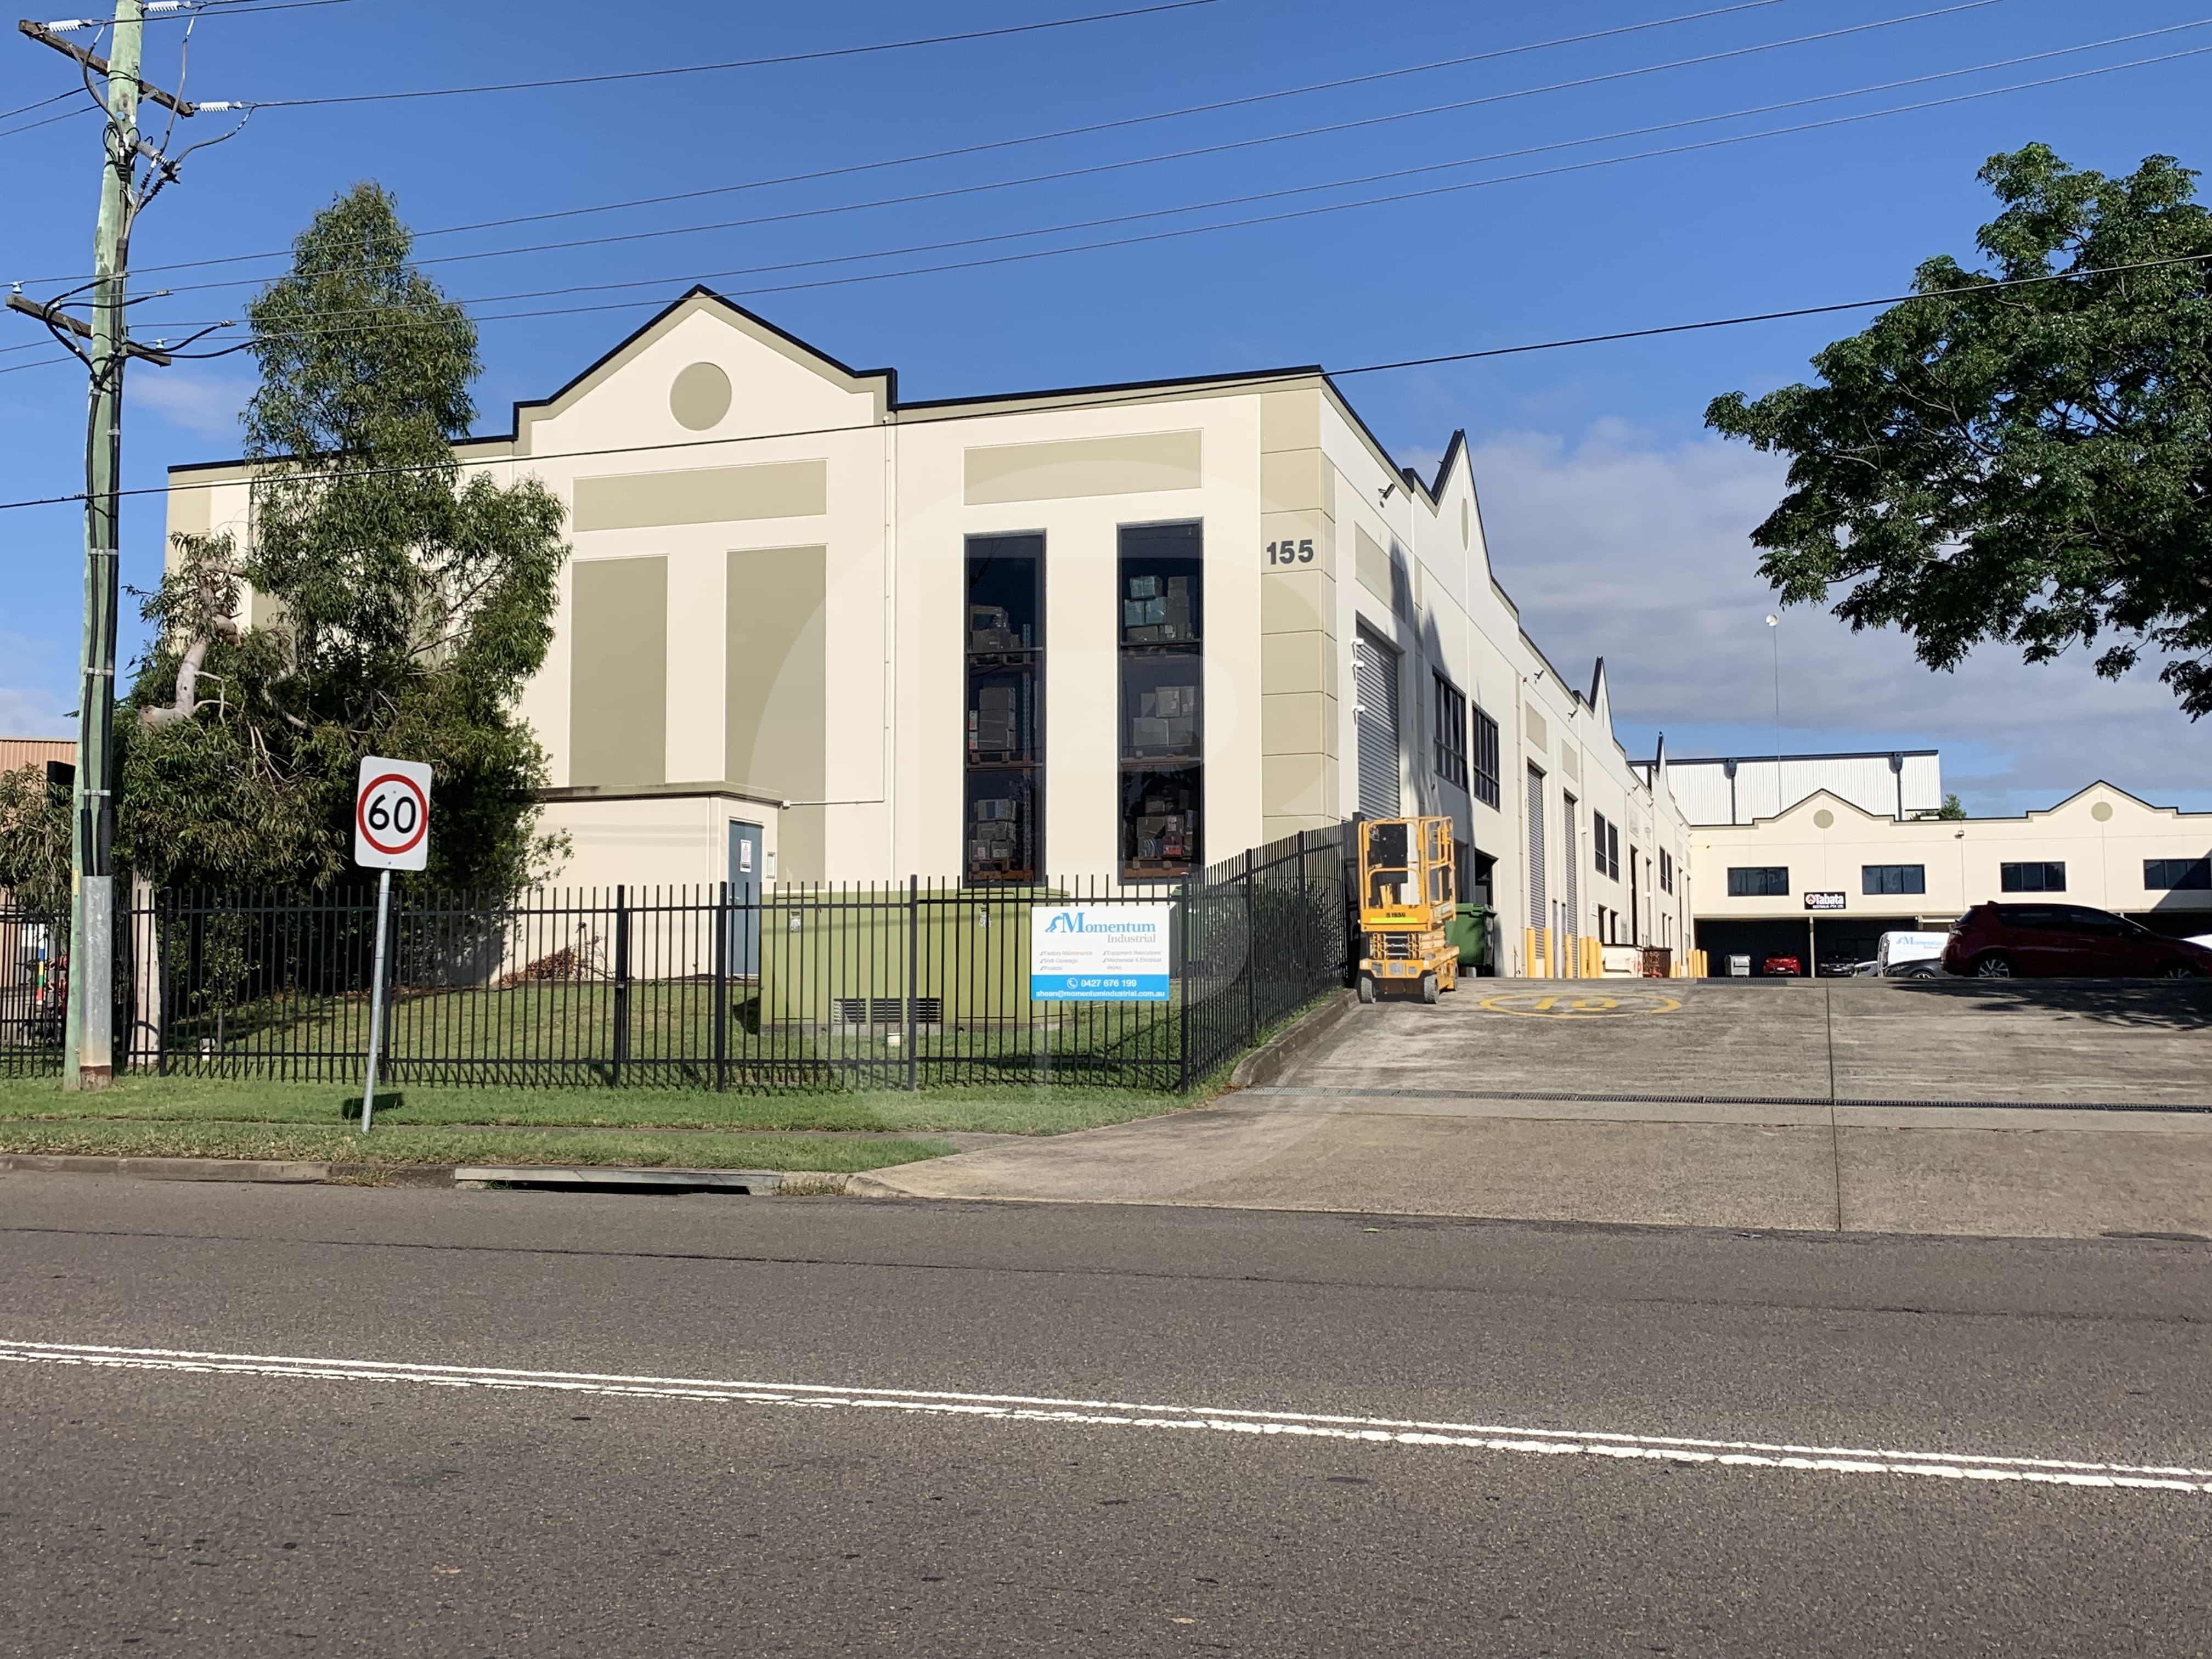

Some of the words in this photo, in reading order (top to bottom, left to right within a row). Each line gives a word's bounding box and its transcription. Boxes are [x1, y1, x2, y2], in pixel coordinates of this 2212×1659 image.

[1266, 539, 1314, 565] 155
[368, 793, 416, 834] 60
[1814, 893, 1844, 905] Tabata
[1060, 912, 1156, 933] Momentum
[1107, 934, 1156, 943] Industrial
